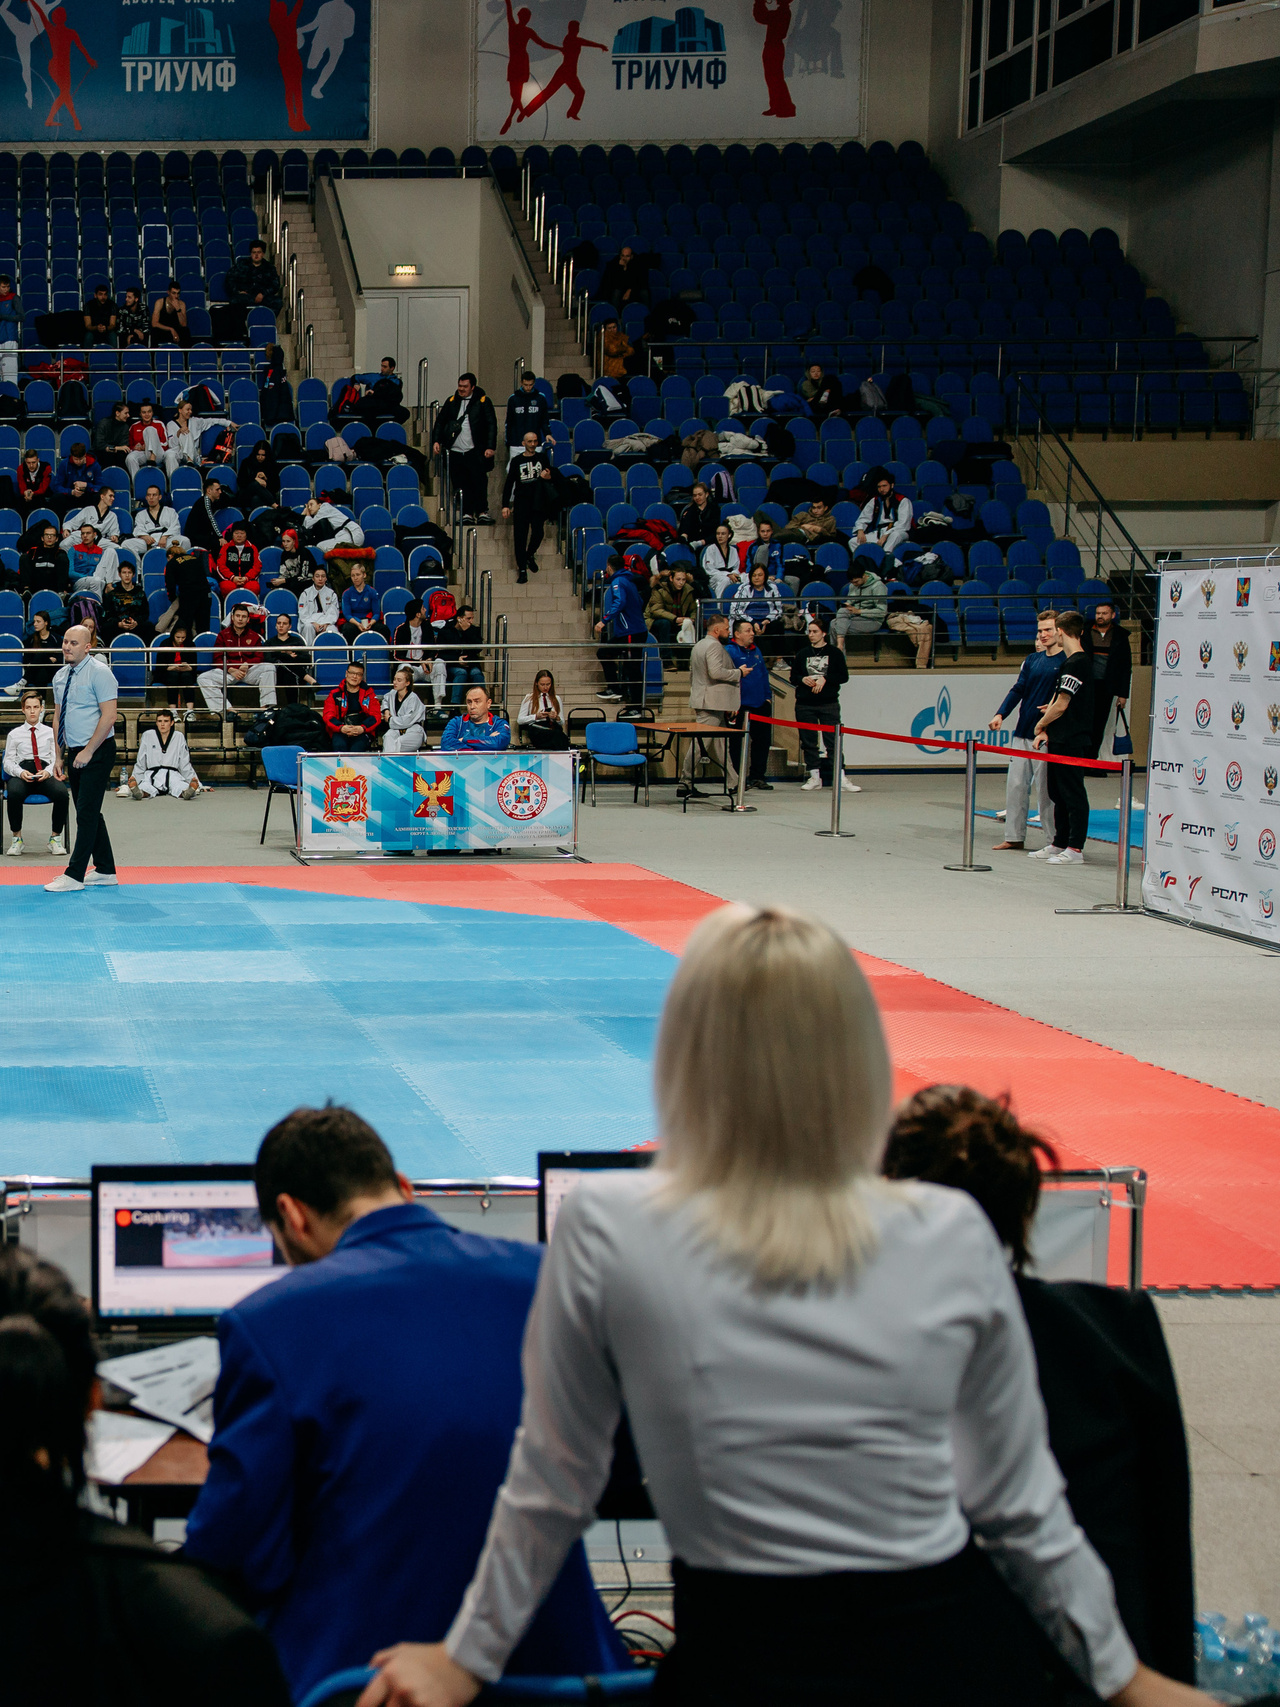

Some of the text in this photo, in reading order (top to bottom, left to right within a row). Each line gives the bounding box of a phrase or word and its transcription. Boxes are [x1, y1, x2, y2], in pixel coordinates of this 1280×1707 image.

[121, 60, 236, 92] ТРИУМФ
[612, 57, 727, 90] ТРИУМФ
[955, 729, 1017, 752] ГАЗПР
[131, 1210, 190, 1227] Capturing
